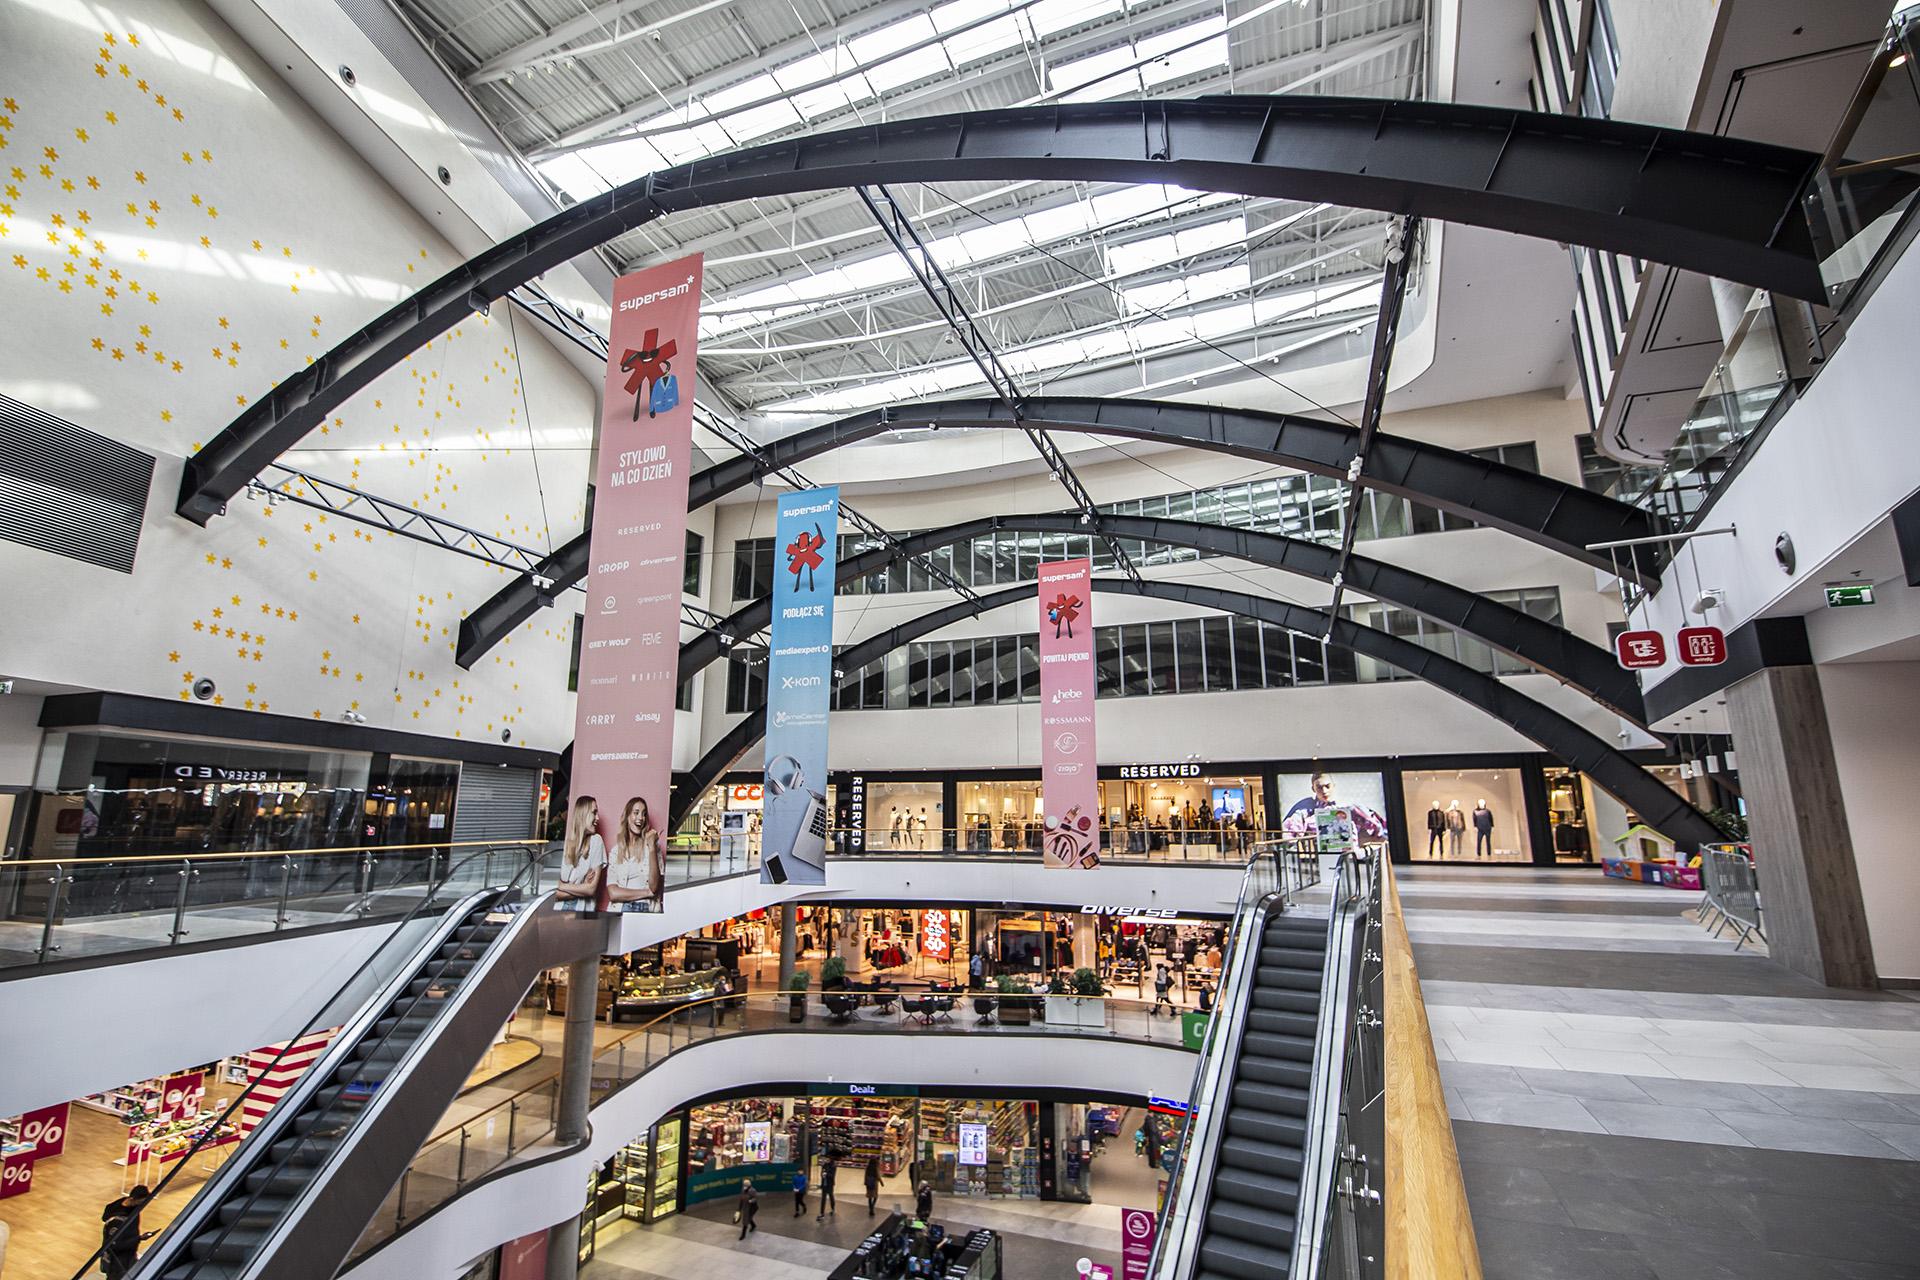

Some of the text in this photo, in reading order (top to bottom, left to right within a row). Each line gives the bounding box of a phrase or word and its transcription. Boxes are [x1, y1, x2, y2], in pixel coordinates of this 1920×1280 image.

[619, 281, 690, 312] supersam
[619, 445, 666, 468] STYLOWO
[611, 461, 672, 488] NA CO DZIEŃ
[783, 502, 831, 518] supersam
[618, 522, 661, 536] RESERVED
[598, 560, 630, 574] CROPP
[1042, 571, 1084, 583] supersam
[783, 605, 825, 619] PODŁĄCZ SIĘ
[1057, 689, 1083, 699] hebe
[585, 714, 616, 725] CARRY
[634, 712, 661, 723] sinsay
[1044, 716, 1092, 725] ROSSMANN
[1120, 765, 1200, 778] RESERVED
[733, 785, 764, 801] CC
[852, 776, 863, 847] RESERVED
[1193, 1022, 1208, 1037] C
[850, 1084, 876, 1094] Dealz
[23, 1116, 63, 1144] %
[3, 1163, 32, 1186] %
